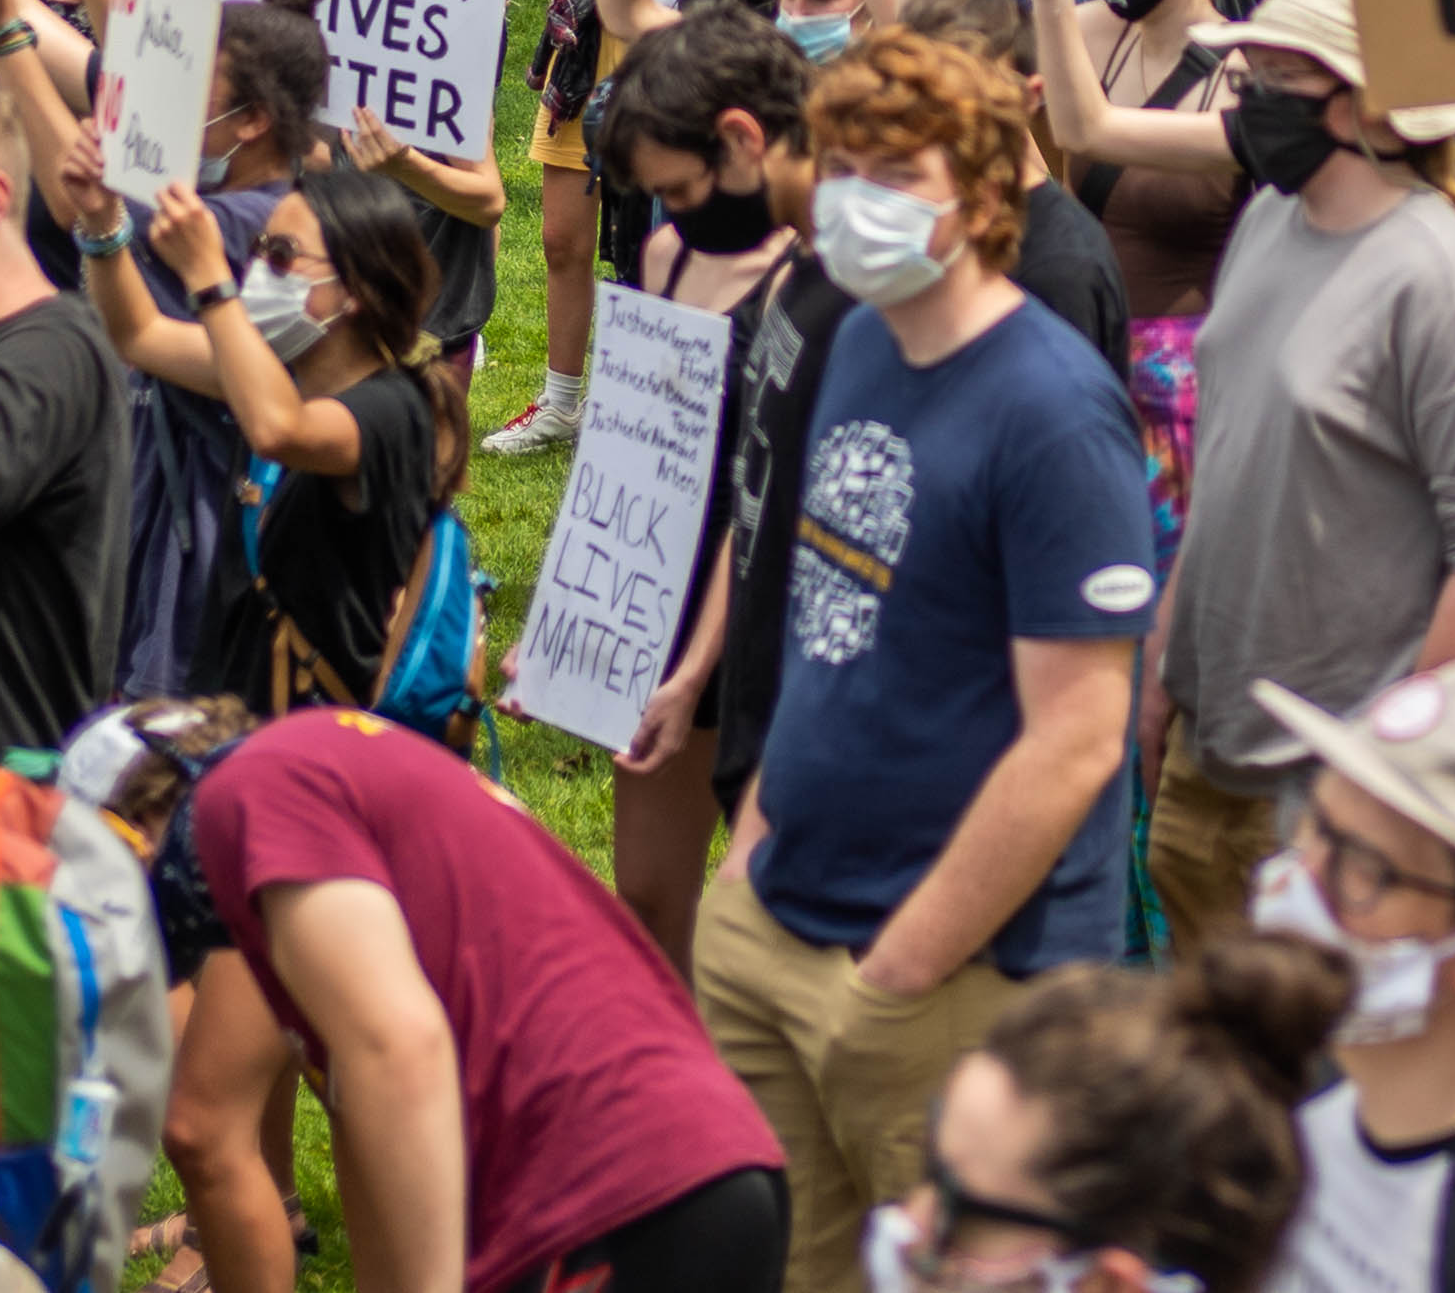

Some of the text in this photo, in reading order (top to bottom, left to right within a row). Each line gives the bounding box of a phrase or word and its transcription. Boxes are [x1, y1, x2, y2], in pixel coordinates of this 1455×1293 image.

[330, 57, 466, 147] TER
[569, 462, 670, 567] BLACK
[551, 528, 674, 651] LIVES
